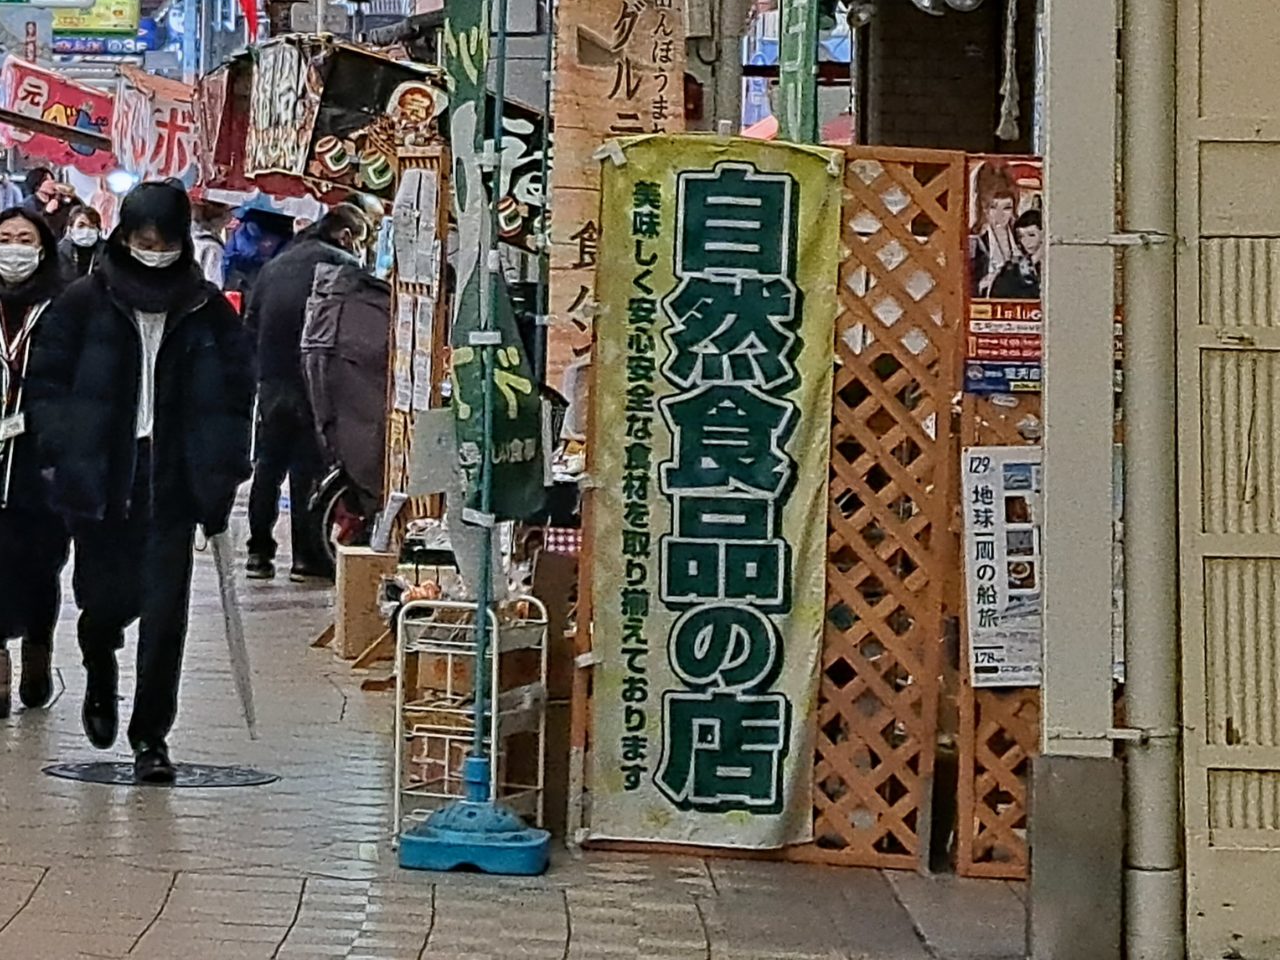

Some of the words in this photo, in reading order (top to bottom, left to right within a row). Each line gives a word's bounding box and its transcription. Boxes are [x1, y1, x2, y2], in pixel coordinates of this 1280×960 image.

[619, 178, 662, 792] 美味しく安心安全な食材を取り揃えております
[654, 162, 802, 814] 自然食品の店
[972, 484, 1000, 629] 地球一周の船旅
